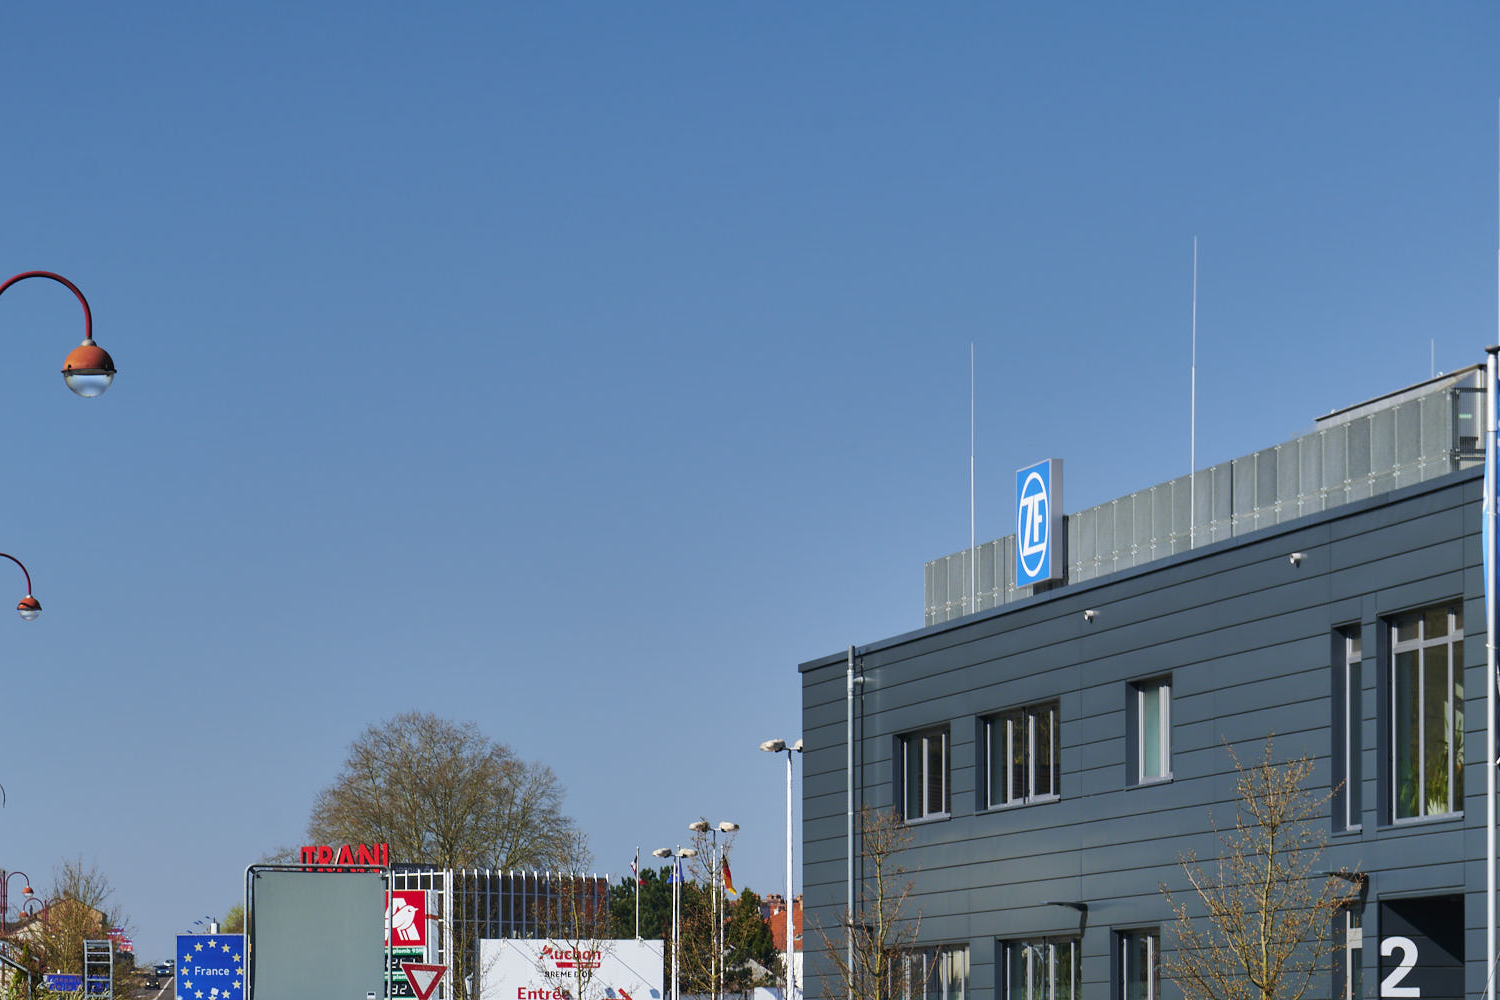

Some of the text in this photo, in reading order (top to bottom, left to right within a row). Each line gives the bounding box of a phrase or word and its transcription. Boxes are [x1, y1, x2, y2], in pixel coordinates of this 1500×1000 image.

[1021, 492, 1046, 557] ZF
[194, 966, 230, 976] France
[539, 945, 601, 960] Auchan
[1381, 936, 1420, 997] 2
